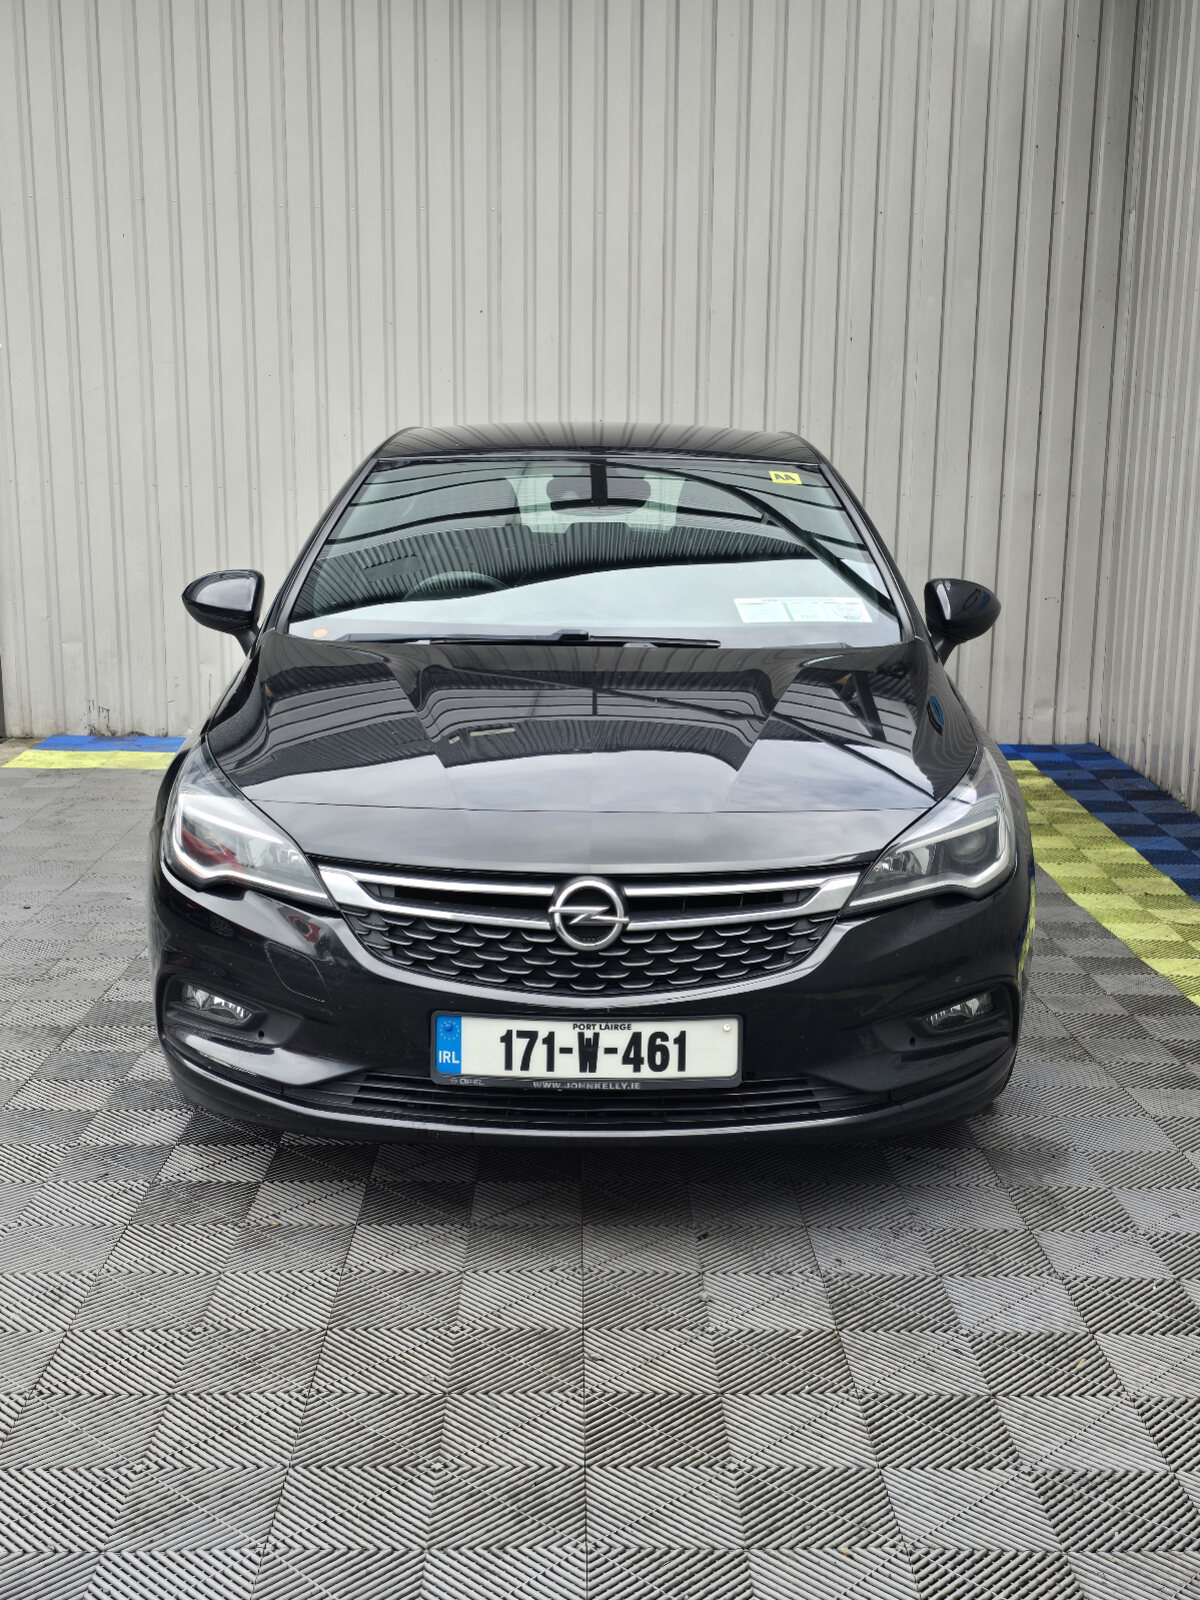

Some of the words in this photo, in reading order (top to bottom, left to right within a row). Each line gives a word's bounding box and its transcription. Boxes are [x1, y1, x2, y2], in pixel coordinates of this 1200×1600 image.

[572, 1022, 597, 1031] PORT
[500, 1029, 686, 1073] 171-W-461
[438, 1050, 460, 1064] IRL
[459, 1078, 485, 1086] OPEL
[532, 1081, 641, 1090] WWW.JOHNKELLY.IE
